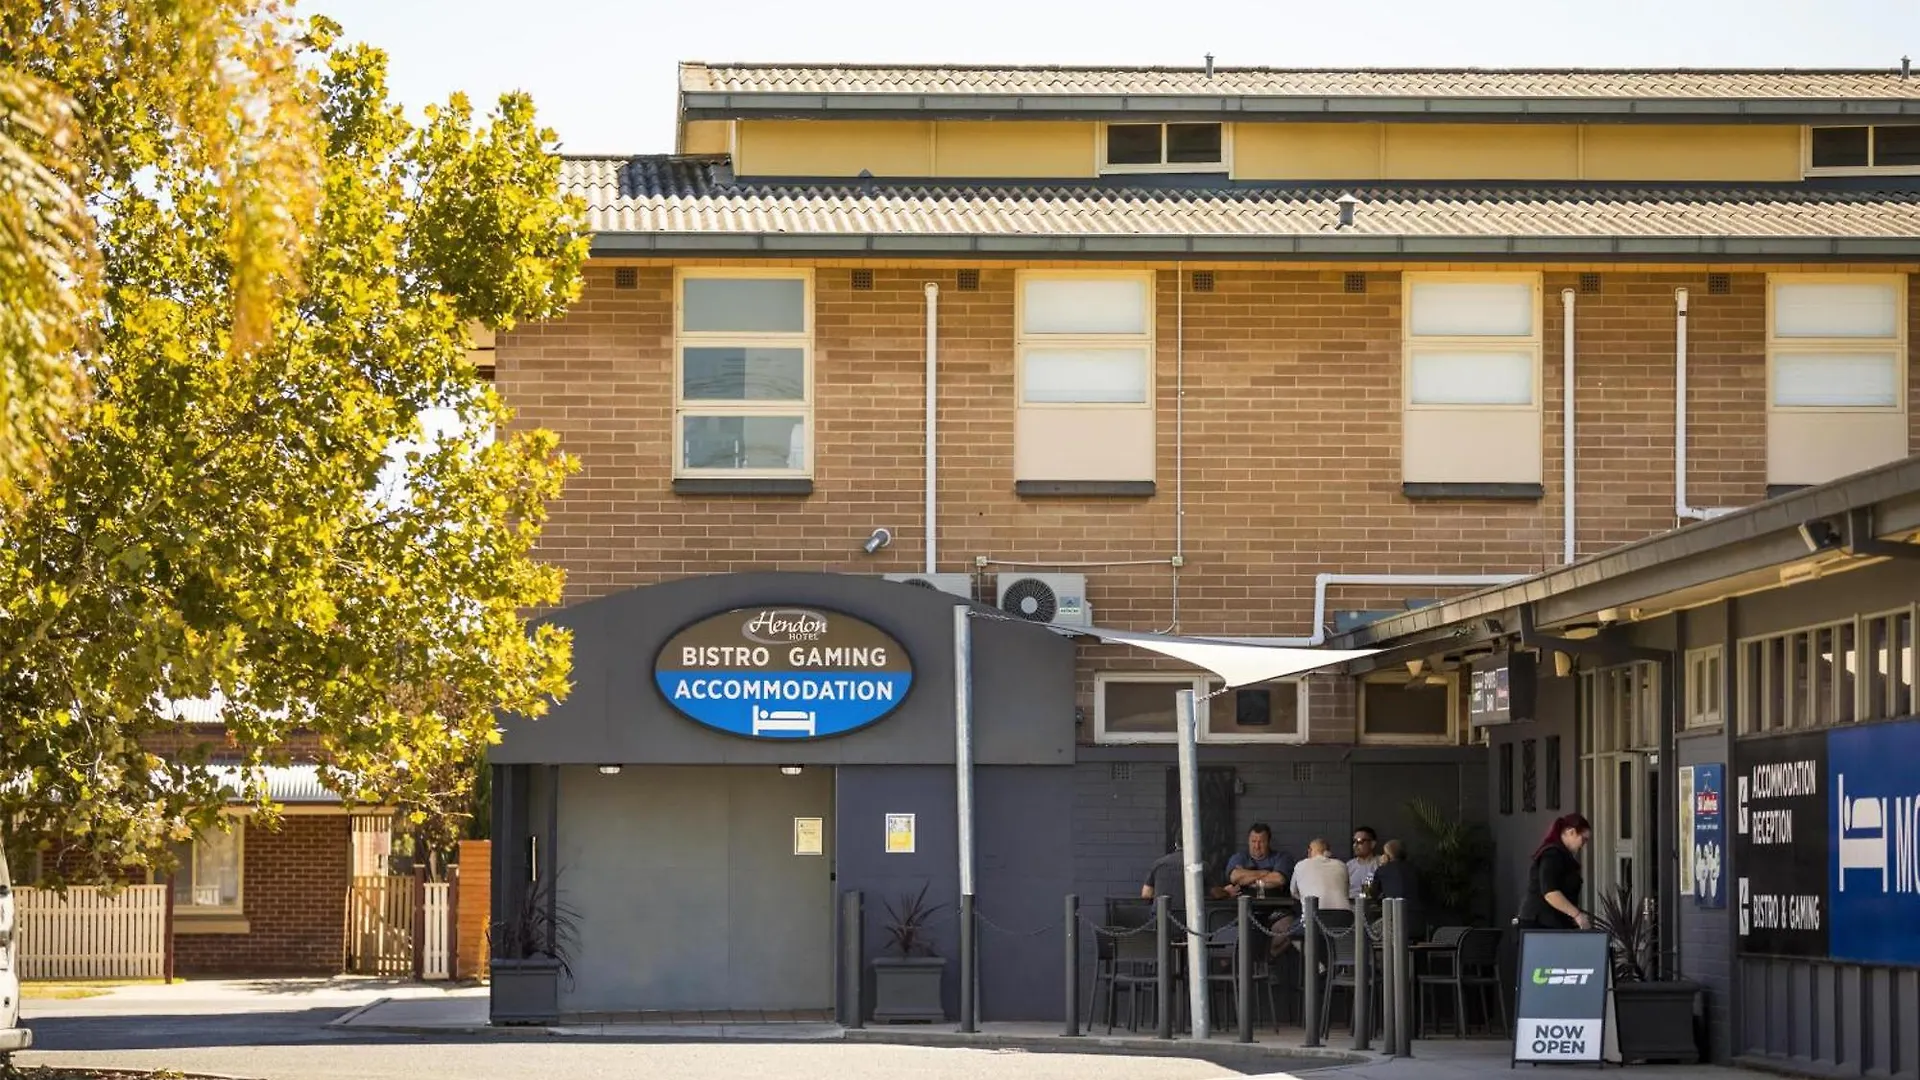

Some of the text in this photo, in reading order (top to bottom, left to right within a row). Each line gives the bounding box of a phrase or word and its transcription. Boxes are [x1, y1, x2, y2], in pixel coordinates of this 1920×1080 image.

[749, 611, 827, 634] Hendon
[789, 633, 819, 641] HOTEL
[682, 647, 887, 667] BISTRO GAMING
[674, 680, 893, 700] ACCOMMODATION
[1752, 760, 1816, 798] ACCOMMODATION
[1752, 810, 1792, 844] RECEPTION
[1753, 895, 1820, 930] BISTRO & GAMING
[1532, 968, 1594, 985] UBET
[1535, 1025, 1584, 1039] NOW
[1532, 1040, 1585, 1054] OPEN
